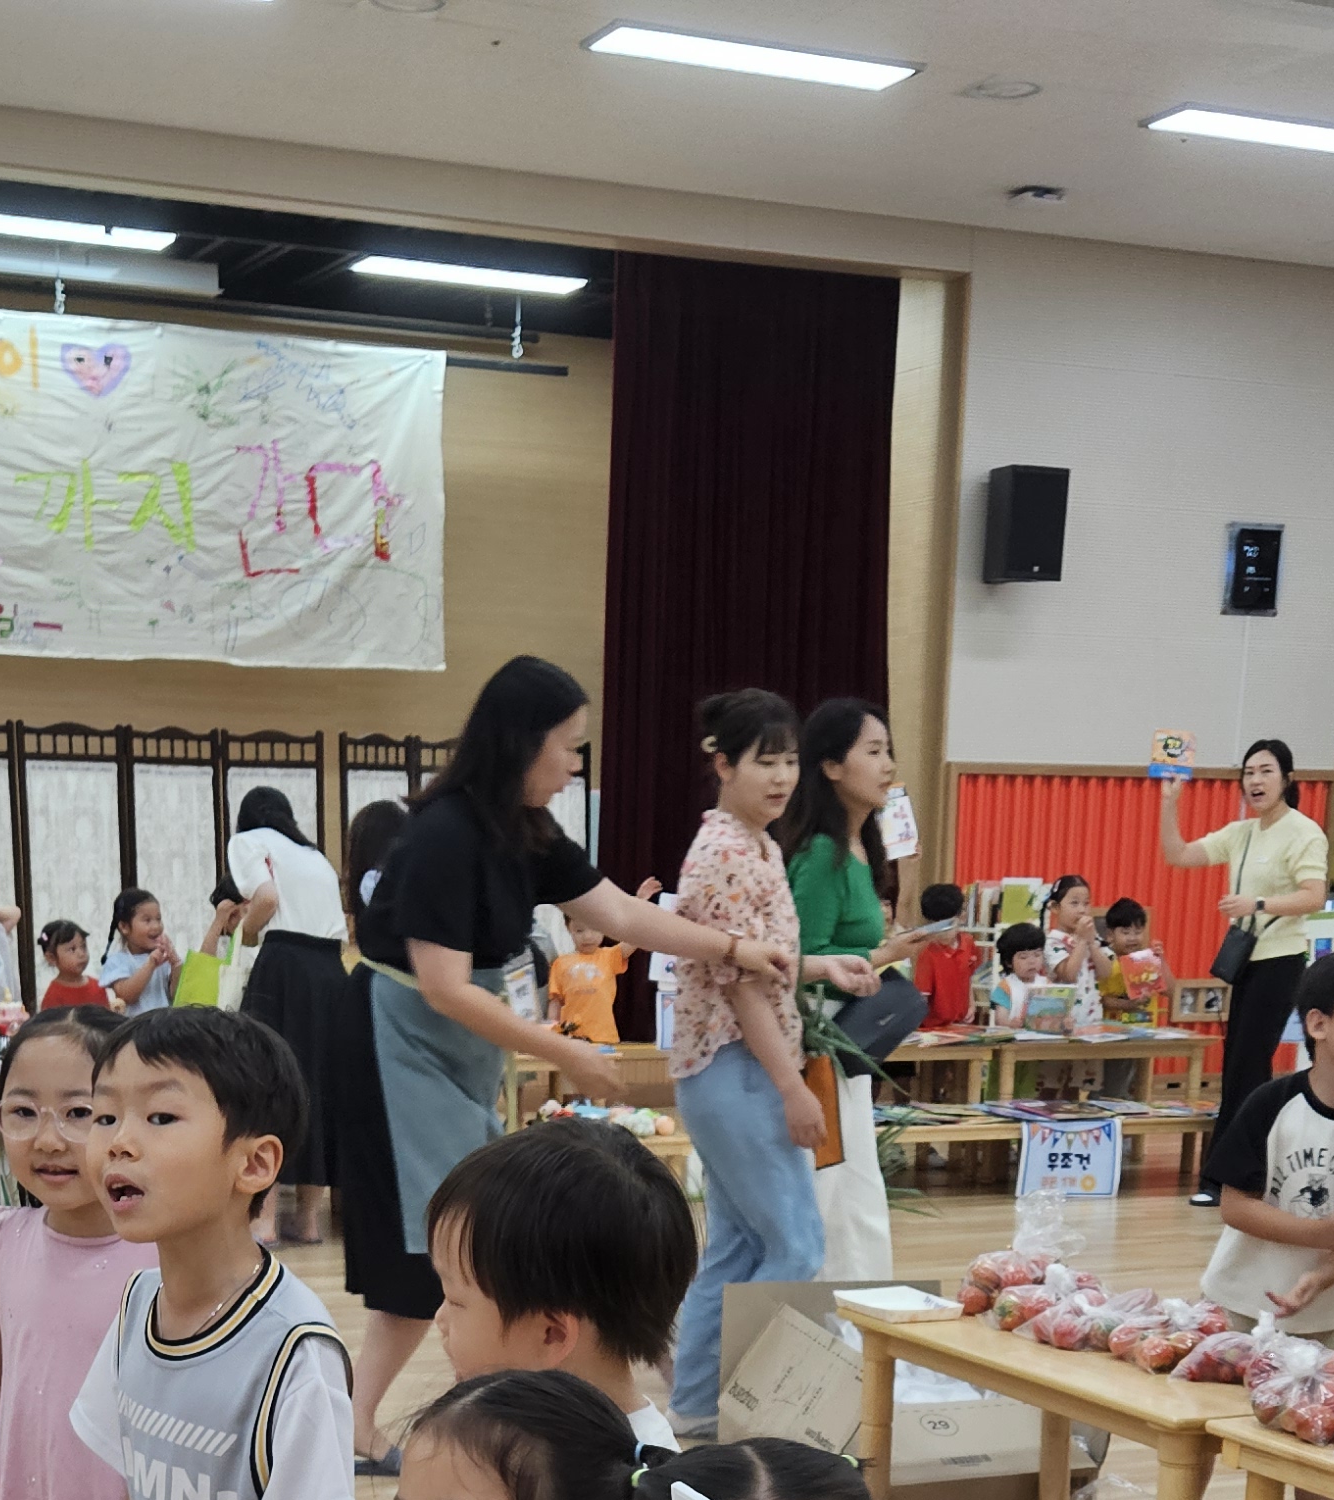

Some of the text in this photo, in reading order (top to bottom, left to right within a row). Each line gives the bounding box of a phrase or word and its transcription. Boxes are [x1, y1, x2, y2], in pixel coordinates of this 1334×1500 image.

[1269, 1165, 1289, 1198] ALL
[1286, 1147, 1329, 1174] TIME
[927, 1420, 950, 1430] 29
